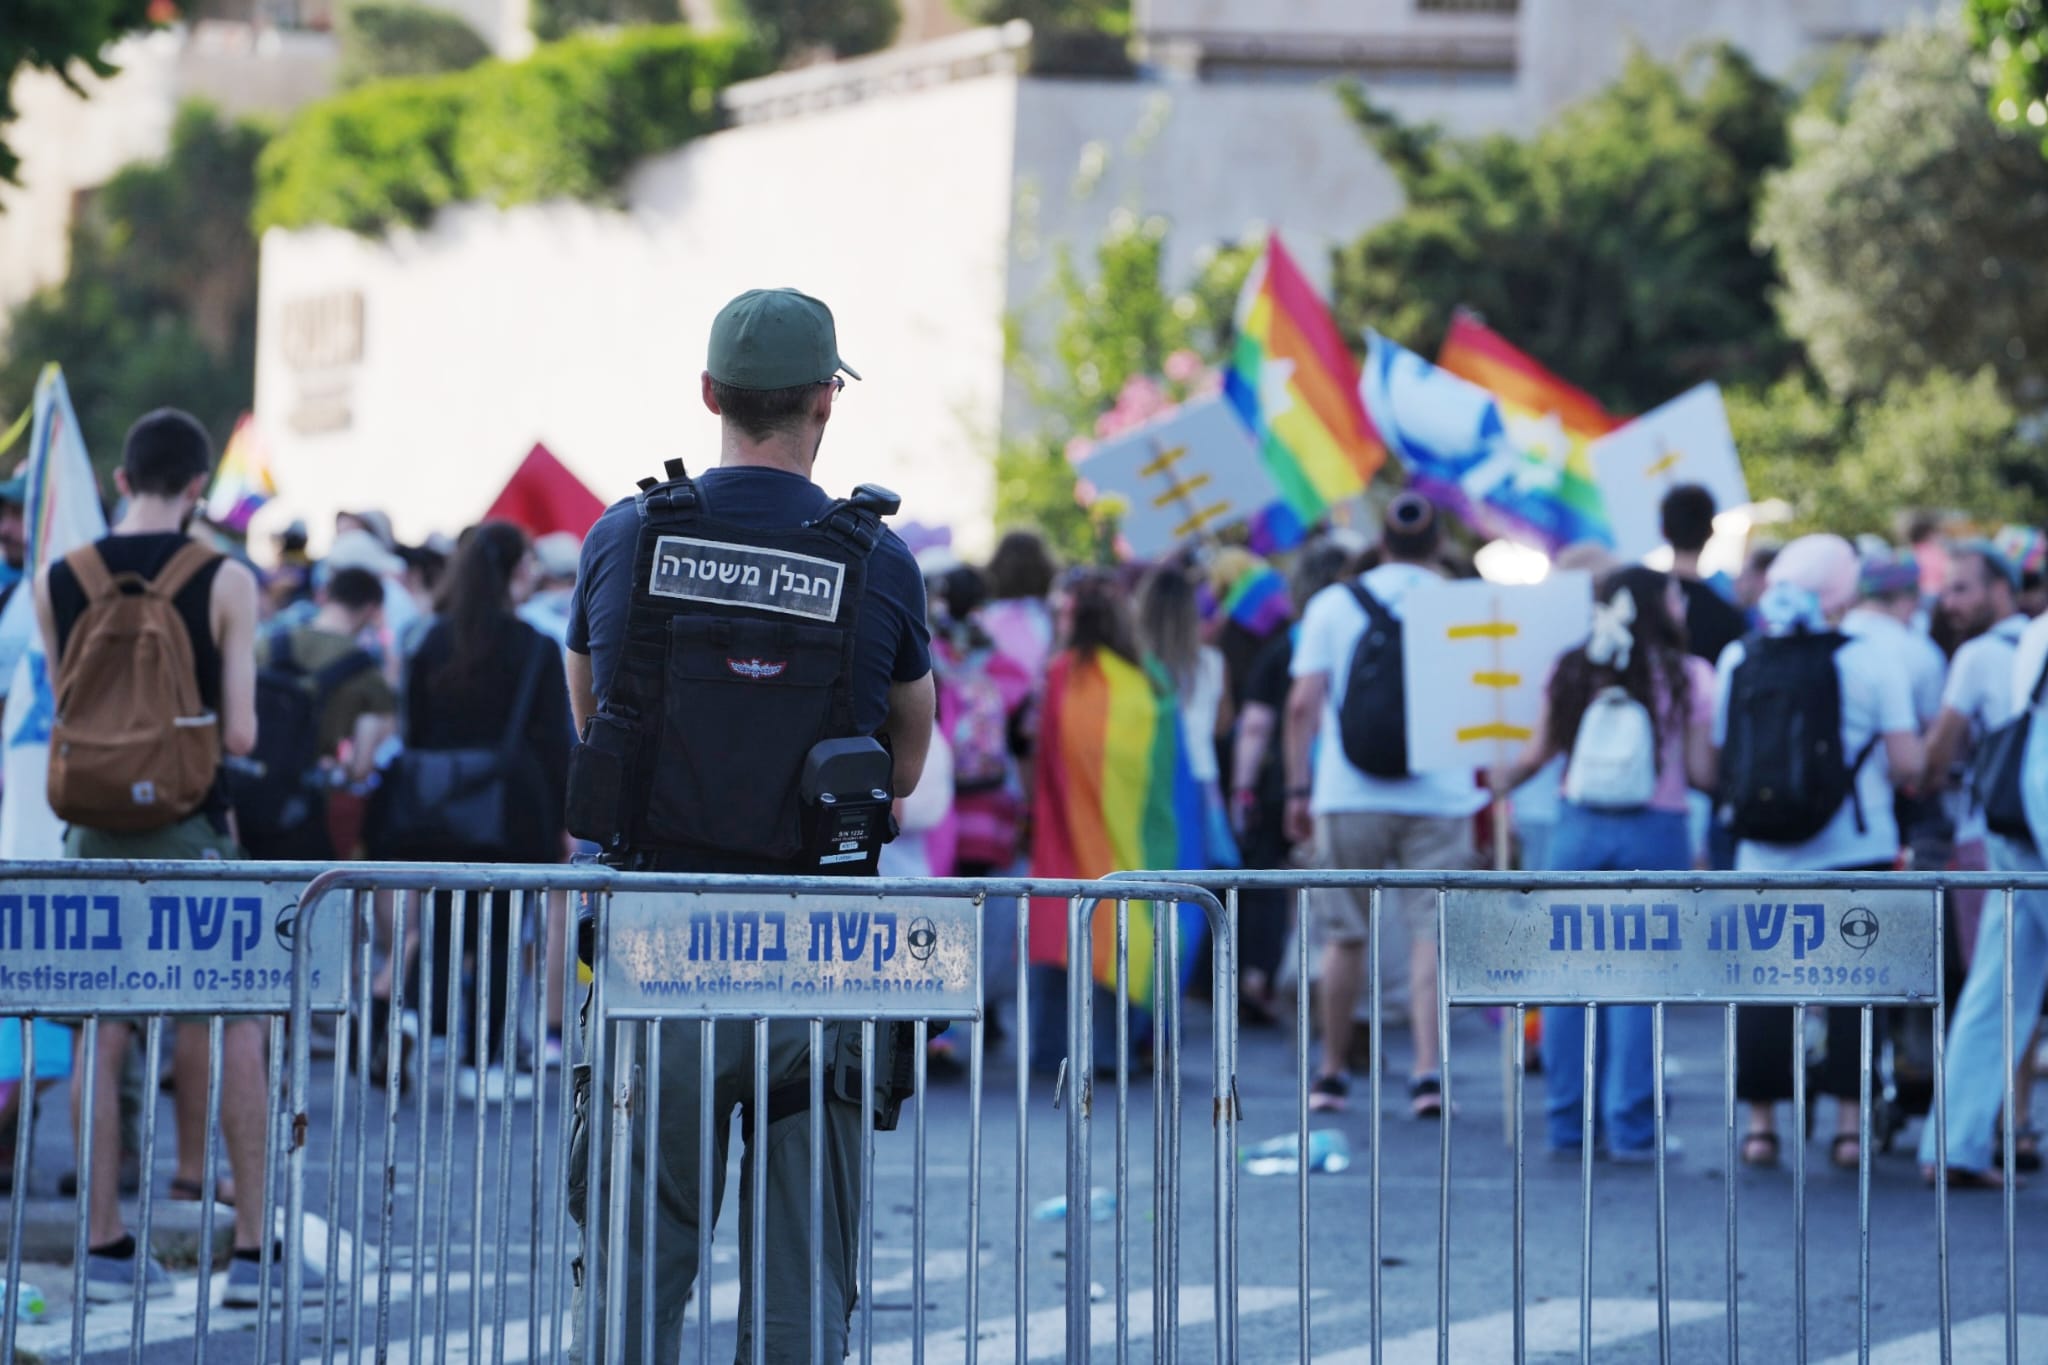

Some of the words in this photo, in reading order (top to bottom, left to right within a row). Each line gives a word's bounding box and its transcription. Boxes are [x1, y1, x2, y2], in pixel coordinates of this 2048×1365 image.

[660, 554, 761, 586] משטרה
[768, 564, 832, 599] חבלן
[0, 894, 122, 951] במות
[148, 896, 262, 961] קשת
[687, 909, 788, 962] במות
[807, 911, 898, 972] קשת
[1548, 903, 1683, 951] במות
[1707, 903, 1825, 960] קשת
[193, 968, 321, 991] 02-583966
[1751, 965, 1891, 987] 02-5839696
